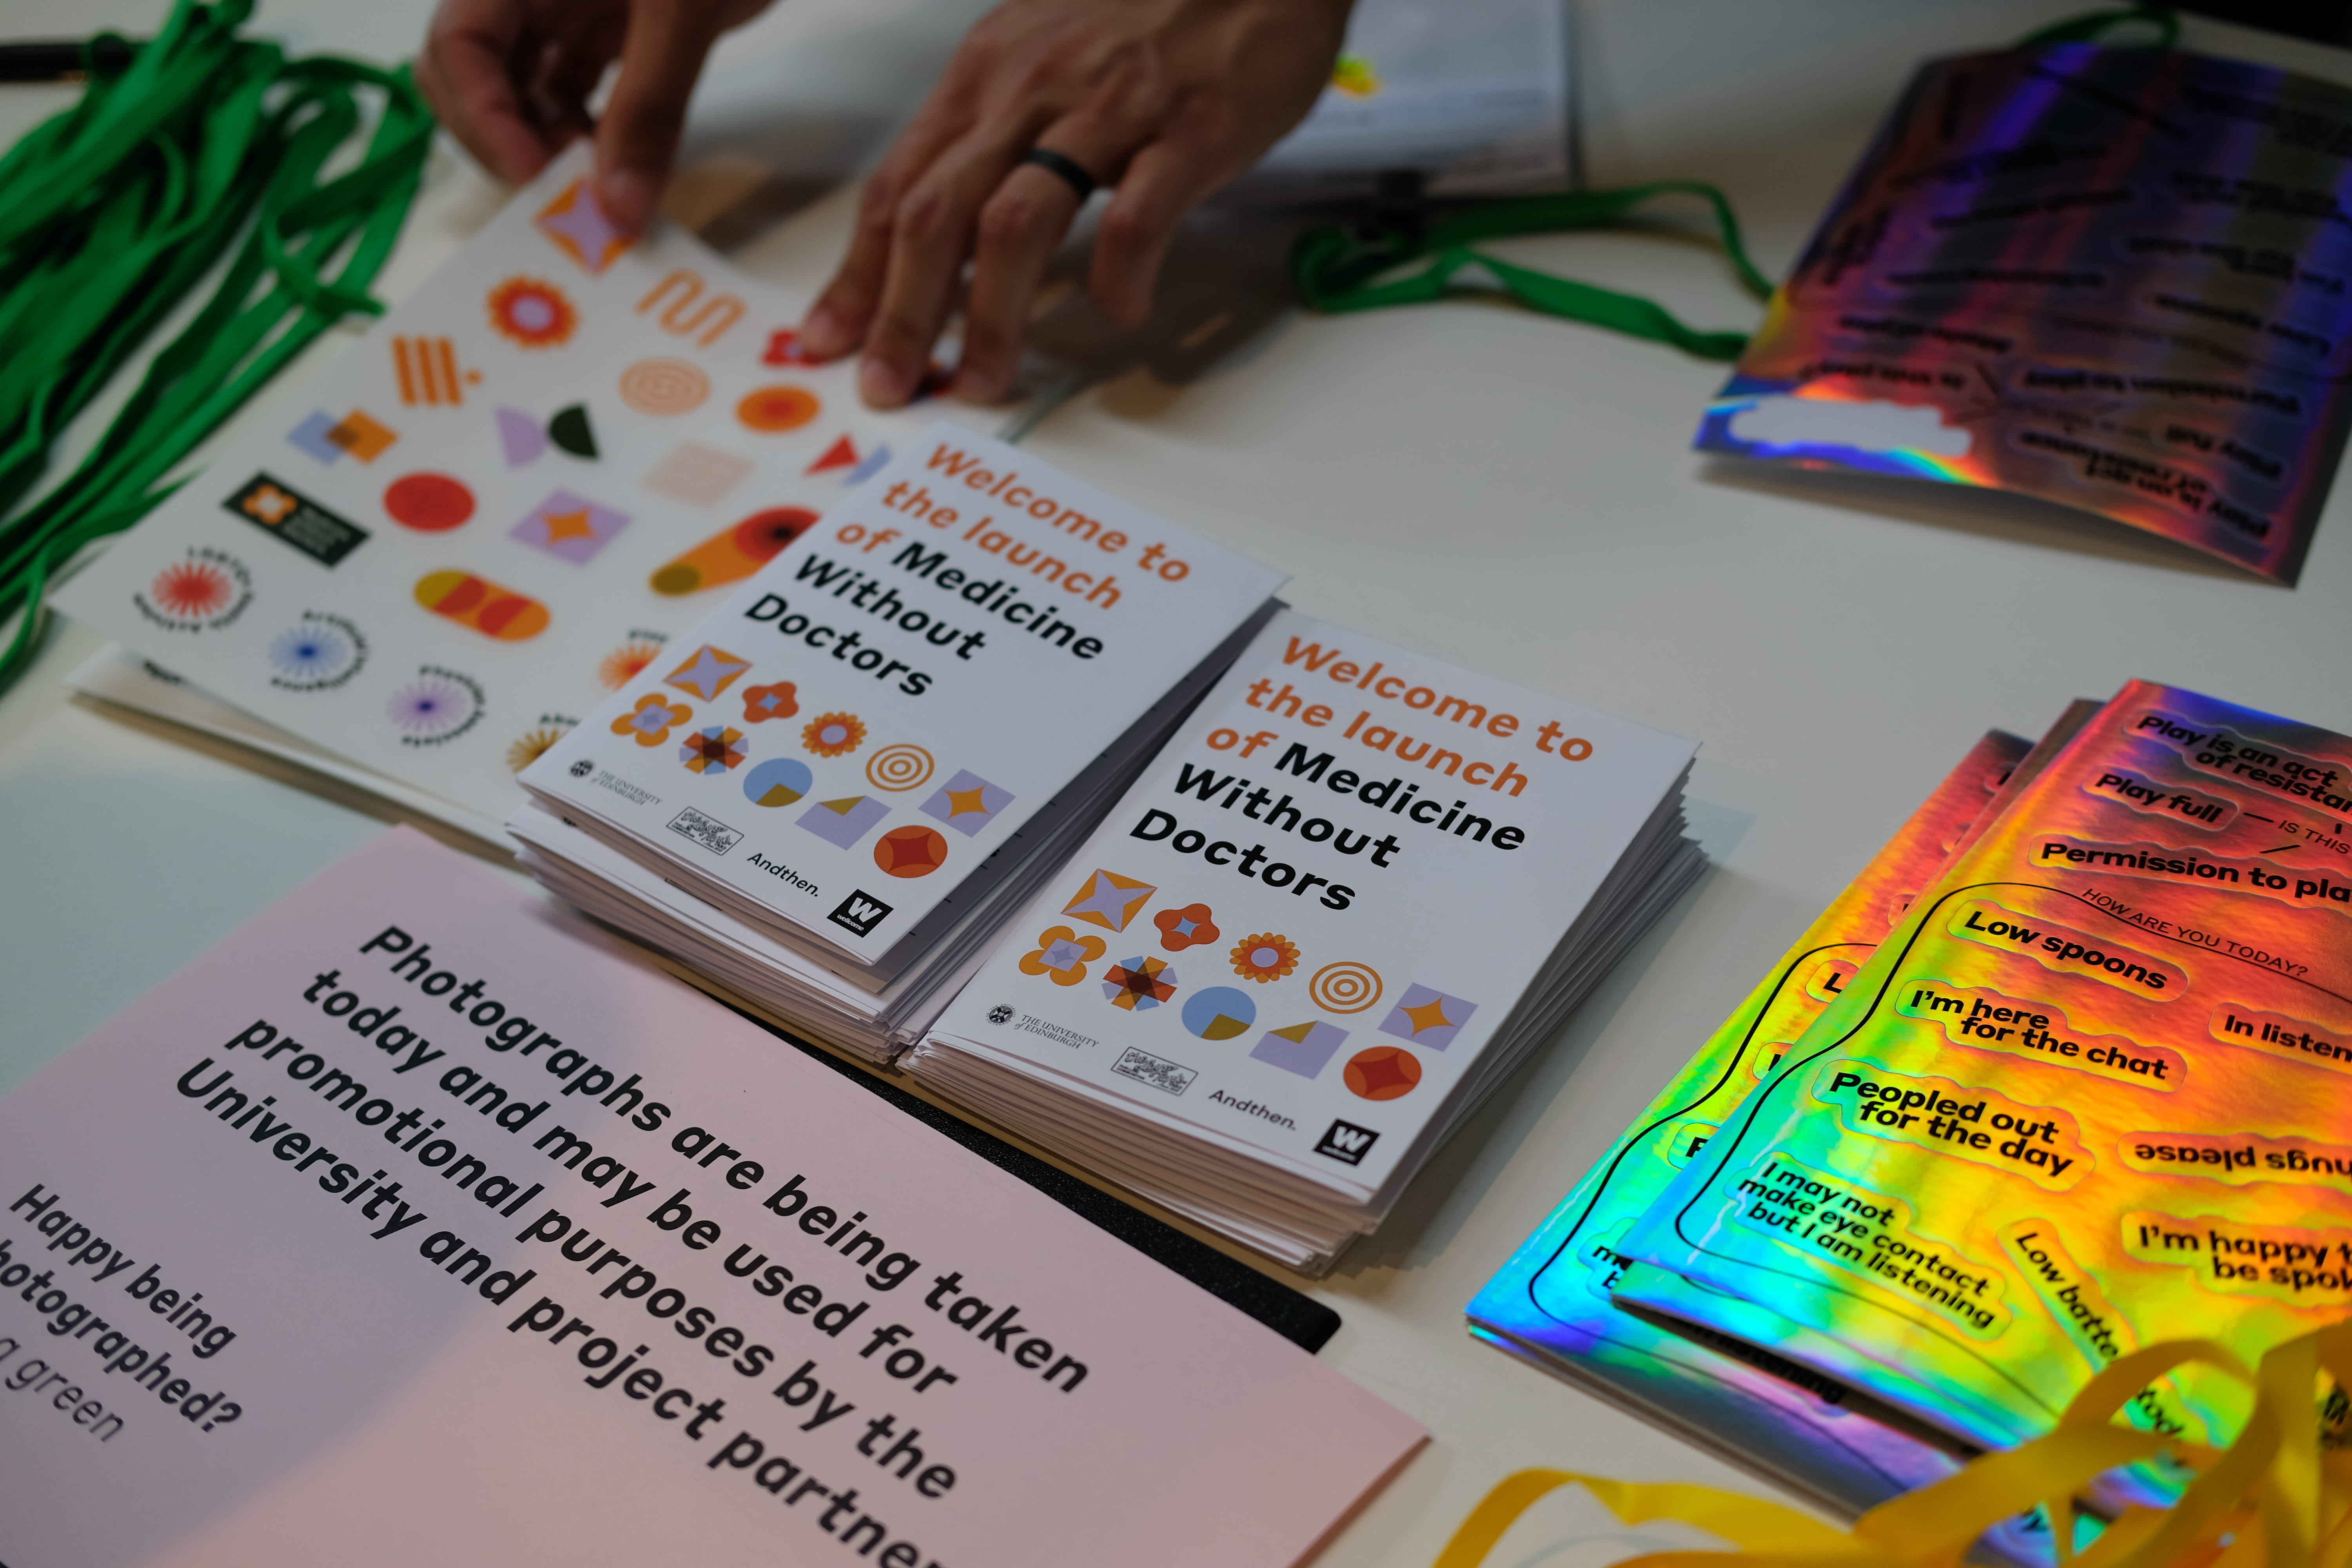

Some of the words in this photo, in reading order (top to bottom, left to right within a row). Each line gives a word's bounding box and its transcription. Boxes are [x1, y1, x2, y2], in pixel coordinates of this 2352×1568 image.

[882, 481, 959, 530] the
[962, 516, 1123, 610] launch
[925, 443, 1129, 554] Welcome
[1138, 543, 1191, 582] to
[795, 554, 987, 661] Without
[836, 523, 901, 553] of
[891, 542, 1104, 660] Medicine
[744, 593, 933, 696] Doctors
[1281, 636, 1520, 738] Welcome
[1535, 721, 1593, 762] to
[1245, 678, 1334, 728] the
[1342, 711, 1528, 797] launch
[2137, 715, 2207, 746] Play
[2207, 734, 2234, 753] is
[2238, 747, 2278, 768] an
[2283, 762, 2338, 788] act
[2196, 751, 2238, 769] of
[599, 769, 616, 781] THE
[615, 778, 663, 805] UNIVERSITY
[599, 779, 647, 806] EDINBURGH
[1174, 762, 1401, 869] Without
[1206, 728, 1279, 759] of
[1274, 742, 1526, 851] Medicine
[2095, 773, 2166, 806] Play
[2167, 794, 2224, 824] full
[1129, 808, 1356, 911] Doctors
[2041, 842, 2240, 883] Permission
[2248, 866, 2288, 891] to
[2294, 878, 2352, 903] pla
[2278, 820, 2299, 834] IS
[2305, 828, 2351, 854] THIS
[746, 852, 819, 897] Andthen.
[848, 897, 883, 923] W
[837, 914, 864, 931] wellcome
[1964, 911, 2041, 944] Low
[2041, 936, 2169, 990] spoons
[2082, 888, 2131, 915] HOW
[2128, 912, 2173, 934] ARE
[2177, 926, 2220, 947] YOU
[2227, 940, 2308, 976] TODAY?
[1021, 1014, 1042, 1026] THE
[1042, 1022, 1099, 1047] UNIVERSITY
[1024, 1024, 1081, 1049] EDINBURGH
[1960, 1016, 2015, 1042] for
[2020, 1030, 2080, 1058] the
[2086, 1047, 2169, 1080] chat
[1970, 997, 2050, 1029] here
[2223, 1014, 2254, 1036] In
[2261, 1022, 2352, 1063] listen
[1208, 1089, 1297, 1132] Andthen.
[1333, 1125, 1370, 1153] W
[1829, 1071, 1987, 1123] Peopled
[1991, 1112, 2060, 1144] out
[1859, 1102, 1920, 1130] for
[1927, 1117, 1993, 1149] the
[1999, 1139, 2074, 1178] day
[303, 969, 446, 1074] today
[439, 1065, 552, 1134] and
[532, 1125, 657, 1208] may
[647, 1188, 722, 1251] be
[723, 1243, 871, 1338] used
[859, 1323, 959, 1396] for
[358, 925, 671, 1132] Photographs
[671, 1125, 765, 1191] are
[762, 1174, 922, 1292] being
[924, 1271, 1091, 1394] taken
[1761, 1162, 1778, 1178] I
[1775, 1169, 1841, 1205] may
[1842, 1196, 1895, 1227] not
[2134, 1143, 2256, 1172] please
[9, 1183, 136, 1283] Happy
[124, 1263, 238, 1360] being
[224, 1019, 545, 1218] promotional
[515, 1208, 775, 1378] purposes
[775, 1360, 856, 1433] by
[856, 1414, 957, 1499] the
[1737, 1179, 1815, 1215] make
[1819, 1209, 1868, 1238] eye
[1873, 1233, 1990, 1297] contact
[1747, 1201, 1800, 1233] but
[1801, 1223, 1817, 1238] I
[1817, 1234, 1864, 1262] am
[1865, 1251, 1996, 1329] listening
[2208, 1229, 2329, 1269] happy
[2336, 1241, 2352, 1265] t
[2212, 1256, 2259, 1282] be
[177, 1057, 428, 1240] University
[419, 1231, 537, 1306] and
[506, 1296, 728, 1441] project
[706, 1430, 946, 1568] partne
[2014, 1230, 2067, 1285] Low
[2057, 1285, 2119, 1360] batte
[4, 1358, 124, 1443] green
